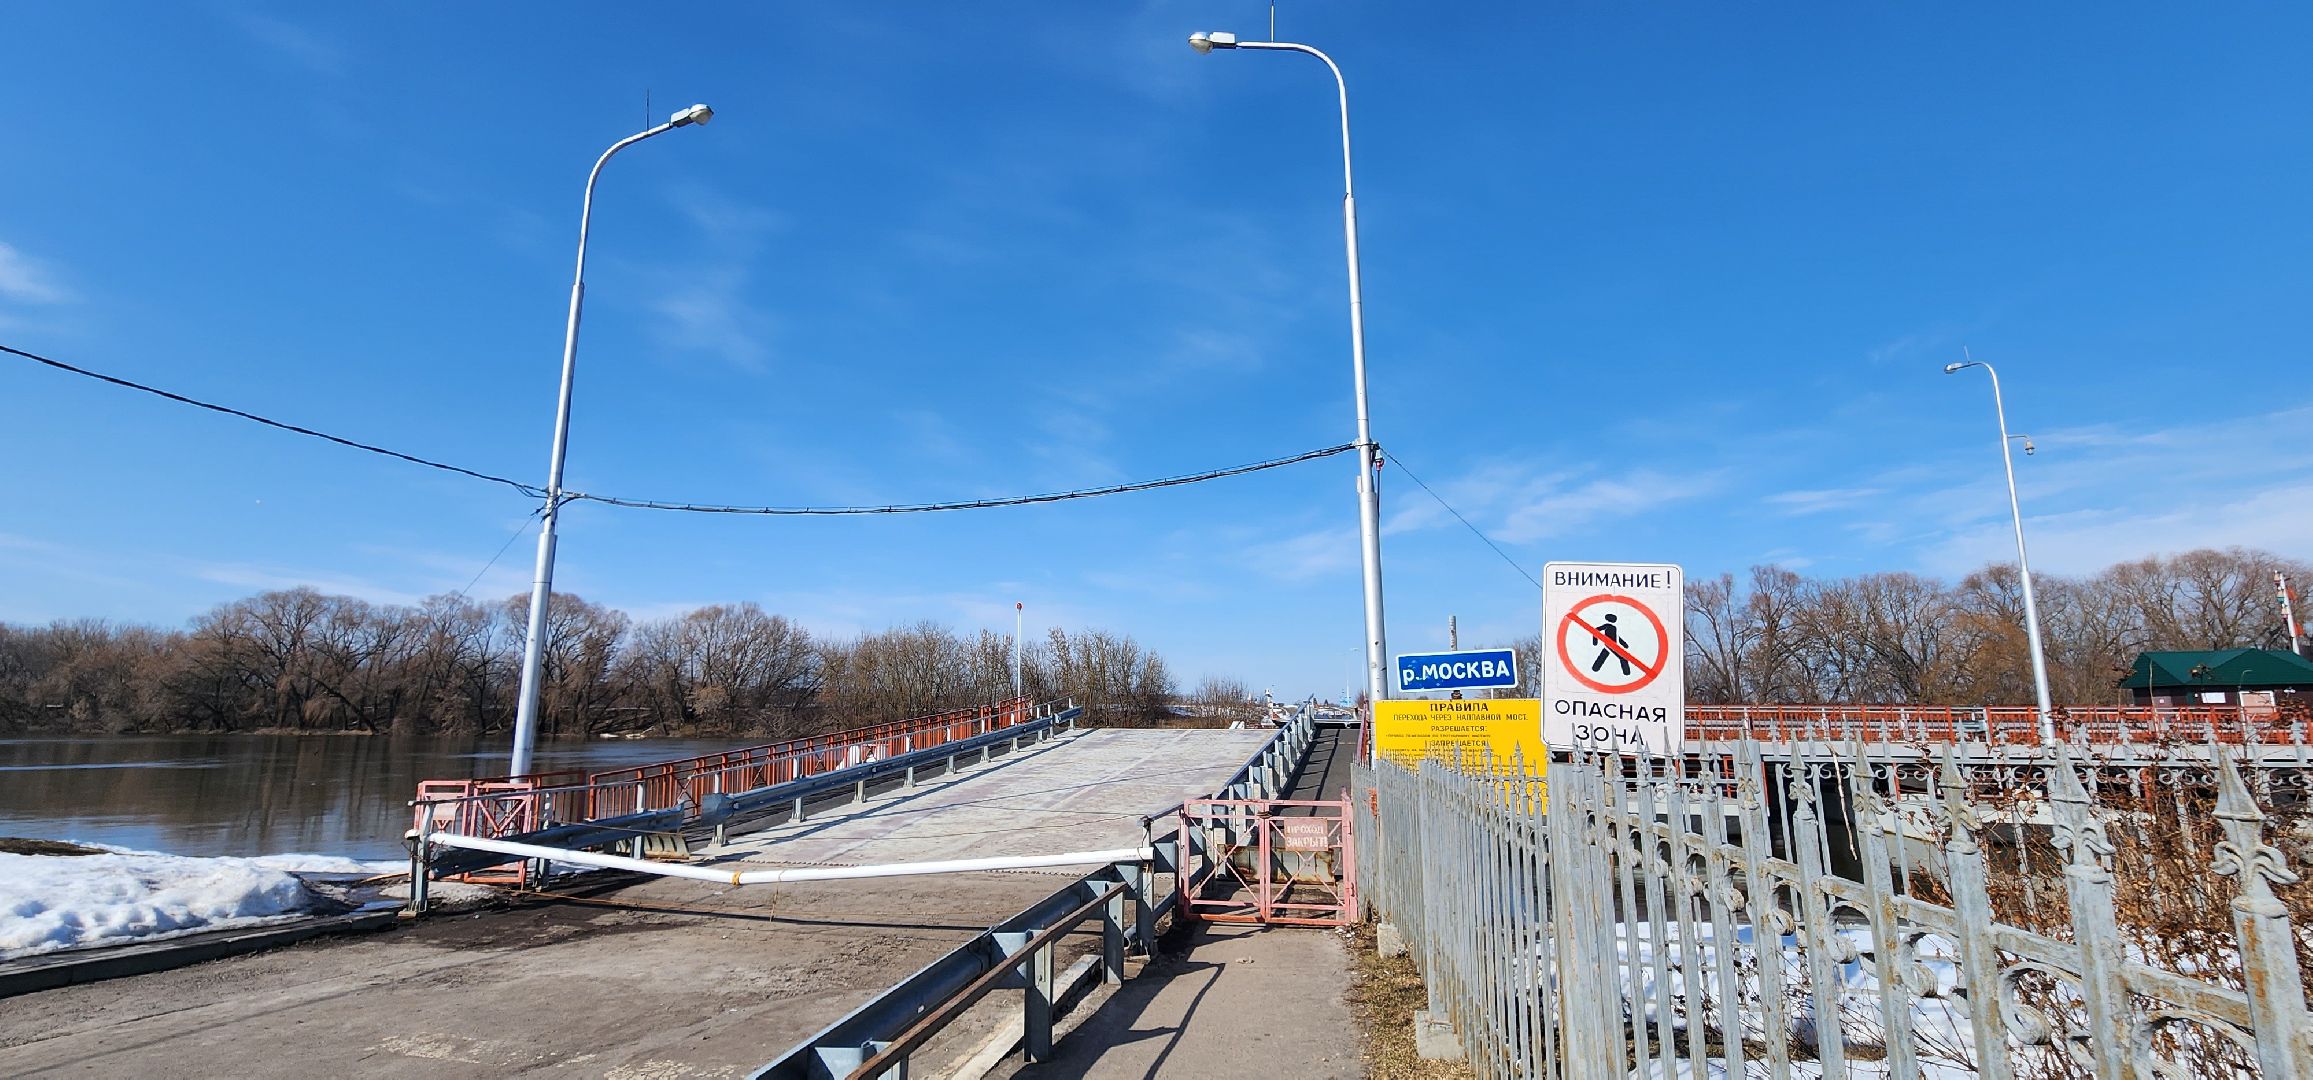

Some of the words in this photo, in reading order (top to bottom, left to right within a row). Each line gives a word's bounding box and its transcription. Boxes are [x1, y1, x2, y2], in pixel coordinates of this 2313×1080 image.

[1430, 702, 1489, 712] ПРАВИЛА
[1554, 699, 1667, 723] ОПАСНАЯ
[1393, 713, 1428, 721] ПЕРЕХОДА
[1430, 713, 1452, 721] ЧЕРЕЗ
[1456, 713, 1501, 721] НАПЛАВНОЙ
[1575, 724, 1645, 746] ЗОНА
[1431, 739, 1486, 747] ЗАПРЕАЕТСЯ
[1286, 824, 1324, 834] ПРОХОД
